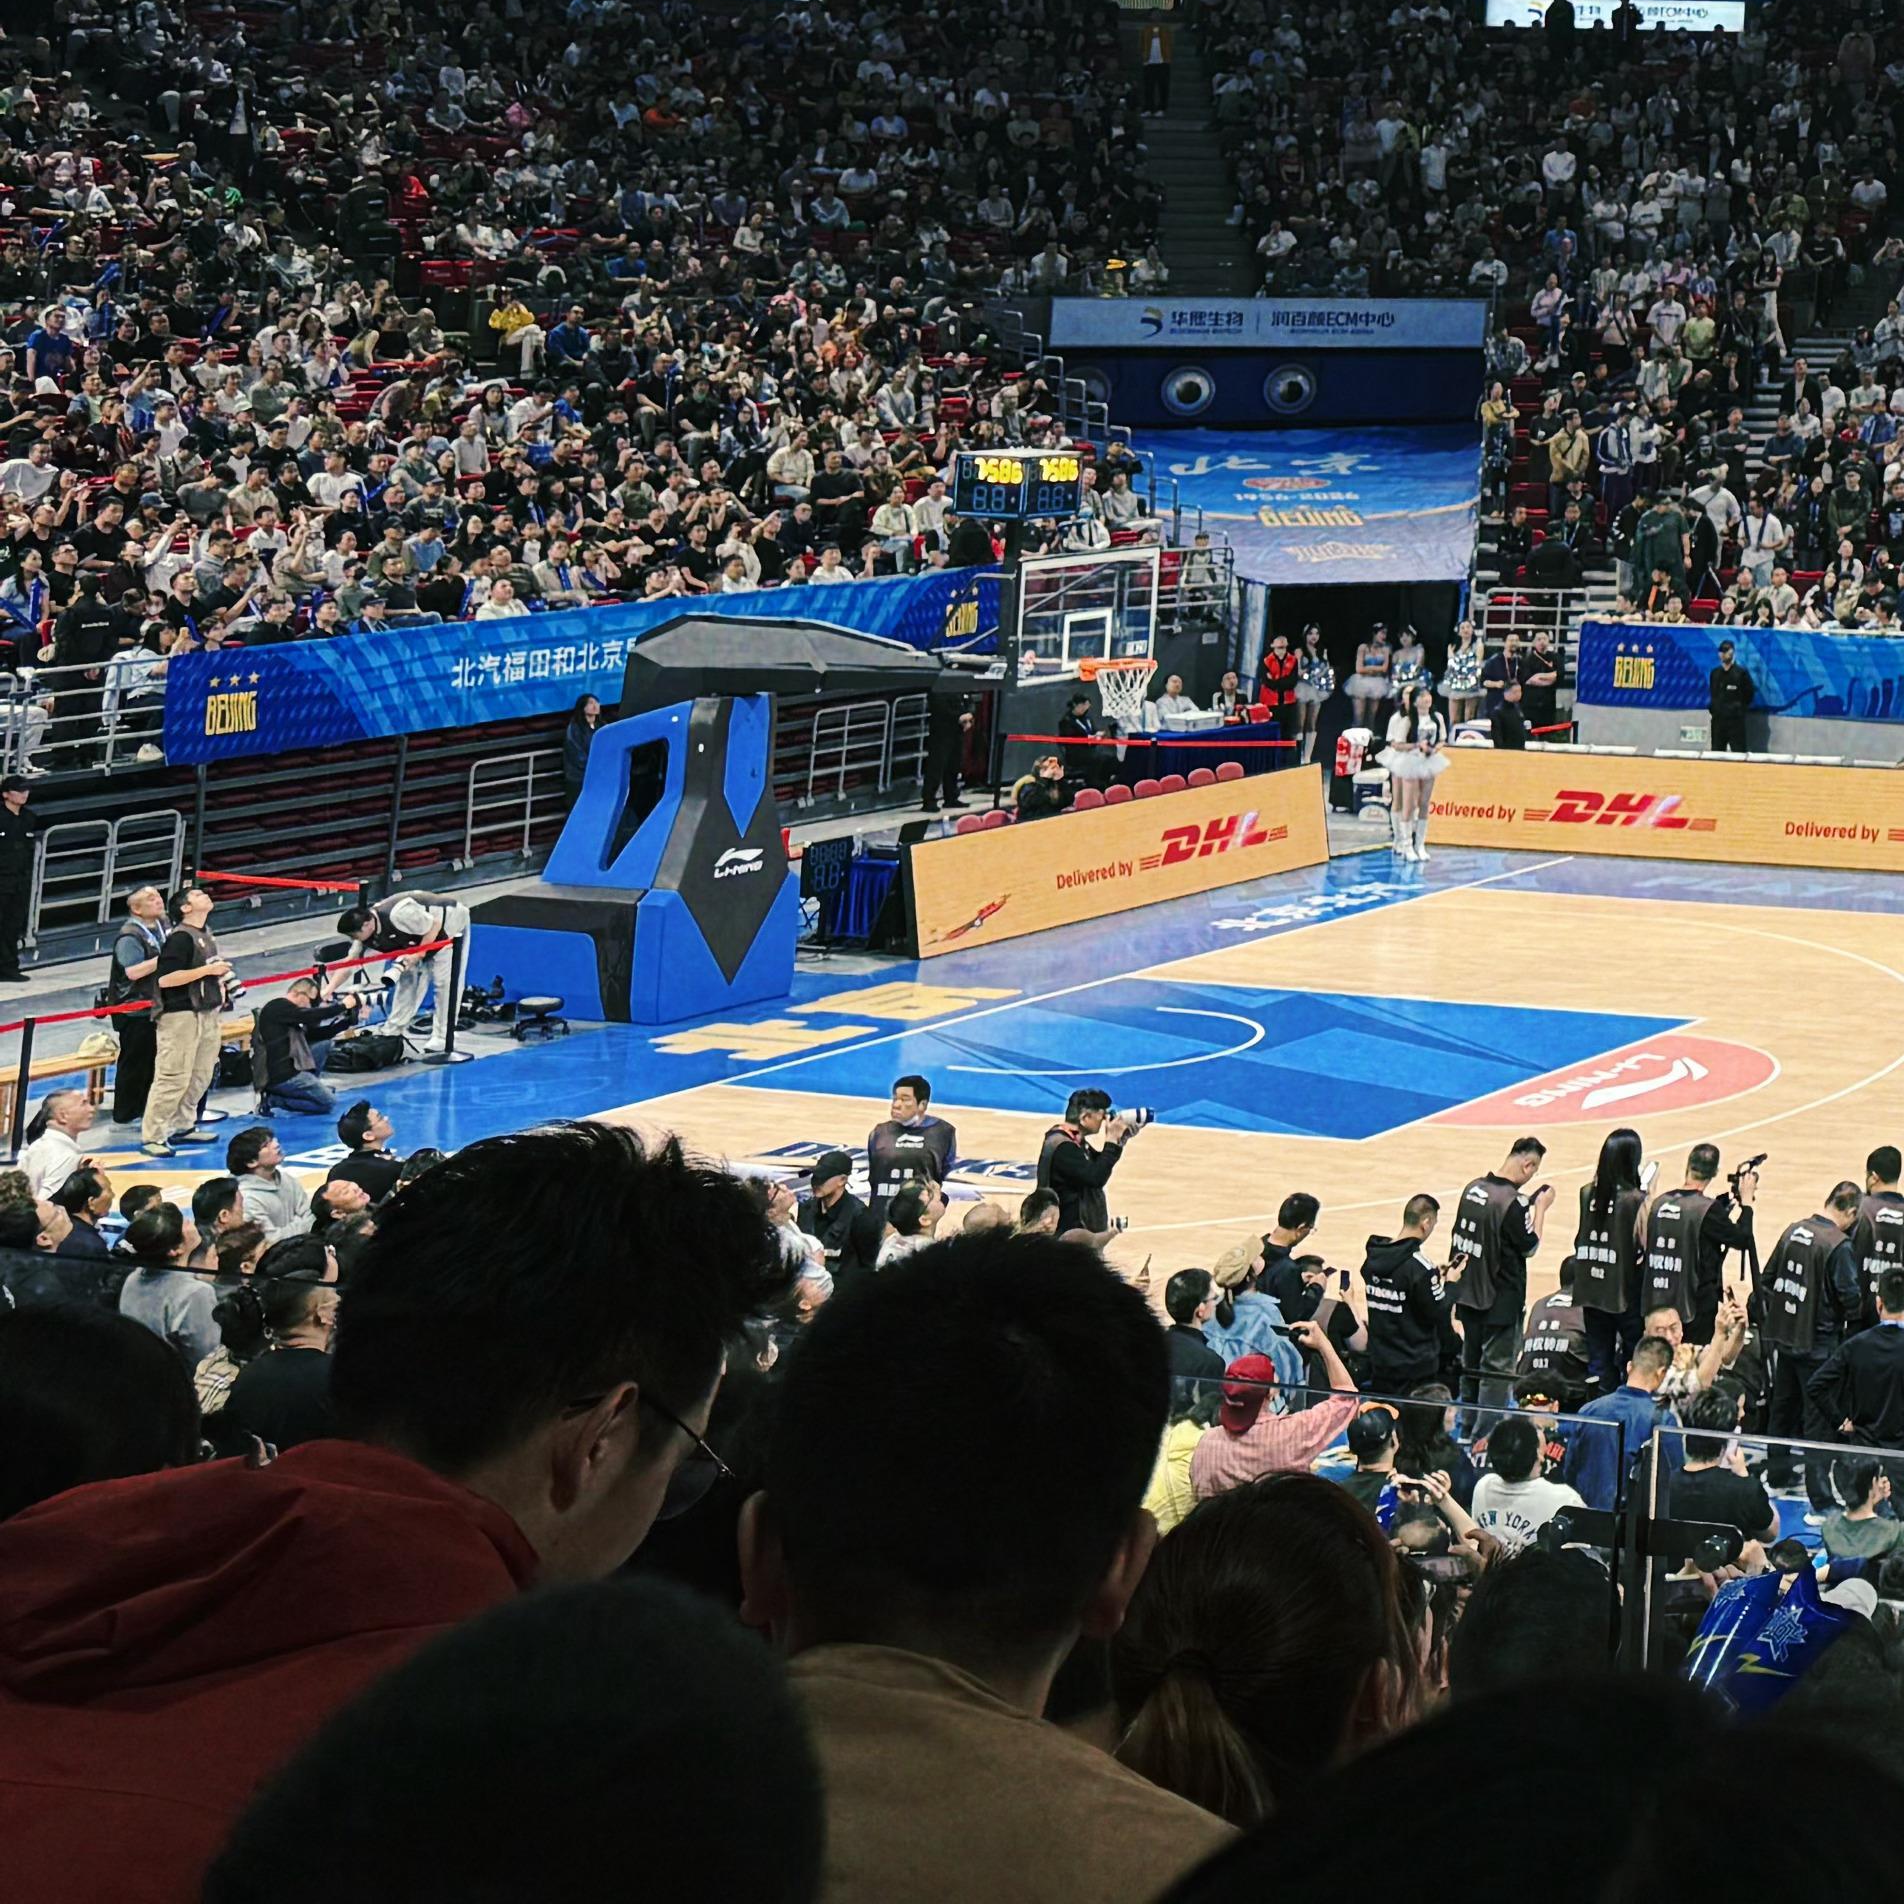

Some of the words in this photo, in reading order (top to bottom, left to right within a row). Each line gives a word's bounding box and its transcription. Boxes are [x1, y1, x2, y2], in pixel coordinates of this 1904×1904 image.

[1171, 311, 1244, 327] 华熙生物
[451, 641, 636, 690] 北汽福田和北京
[1613, 655, 1655, 690] BEIJING
[205, 692, 257, 736] BEIJING
[1496, 804, 1517, 825] by
[1549, 790, 1691, 830] DHL
[1160, 809, 1269, 866] DHL
[1784, 819, 1857, 841] Delivered
[1860, 824, 1881, 844] by
[714, 861, 763, 879] LI-NING
[1056, 864, 1113, 891] Delivered
[1116, 860, 1134, 882] by
[1514, 1053, 1666, 1107] LI-NING
